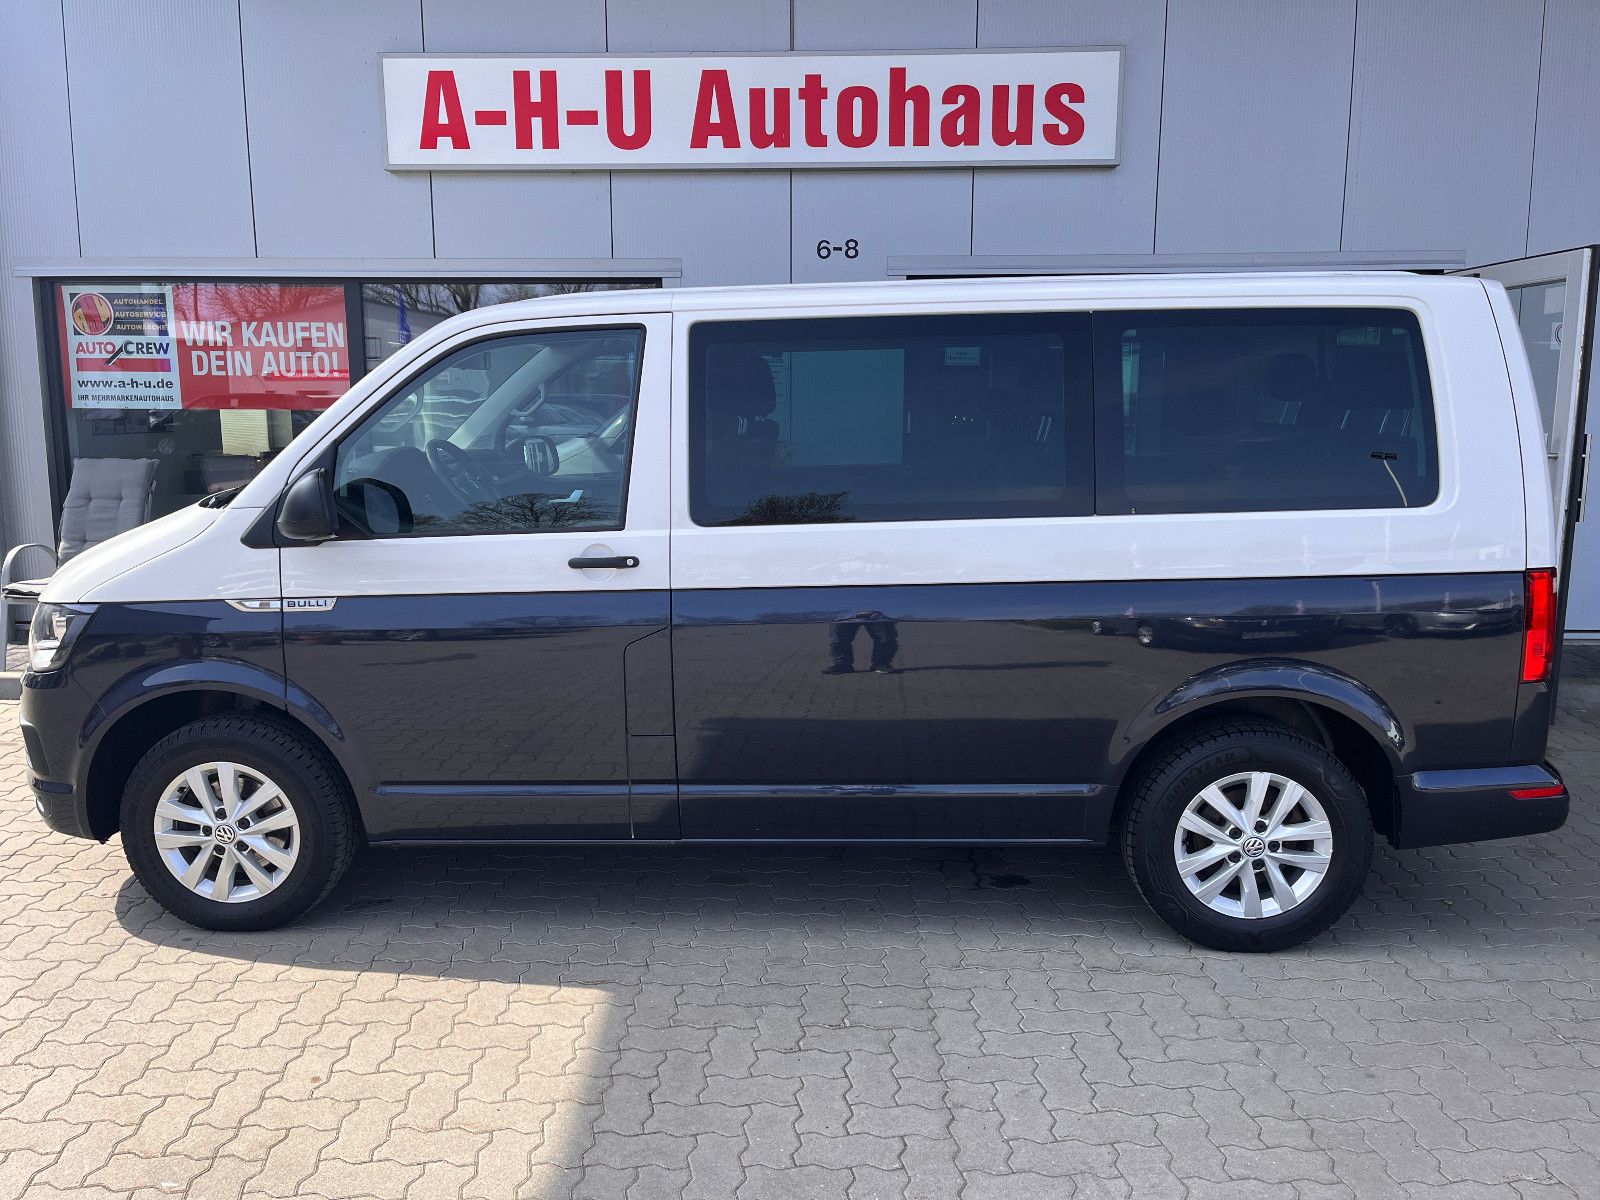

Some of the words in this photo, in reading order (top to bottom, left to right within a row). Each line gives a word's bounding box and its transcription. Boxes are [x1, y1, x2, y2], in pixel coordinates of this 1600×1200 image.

[419, 69, 652, 150] A-H-U
[689, 66, 1086, 149] Autohaus
[816, 238, 859, 260] 6-8
[181, 320, 234, 347] WIR
[241, 321, 345, 348] KAUFEN
[76, 341, 116, 355] AUTO
[123, 340, 170, 355] CREW
[191, 350, 253, 377] DEIN
[260, 351, 340, 378] AUTO!
[77, 378, 174, 389] www.a-h-u.de
[91, 394, 174, 402] MEHRMARKENAUTOHAUS
[287, 600, 327, 608] BULLI
